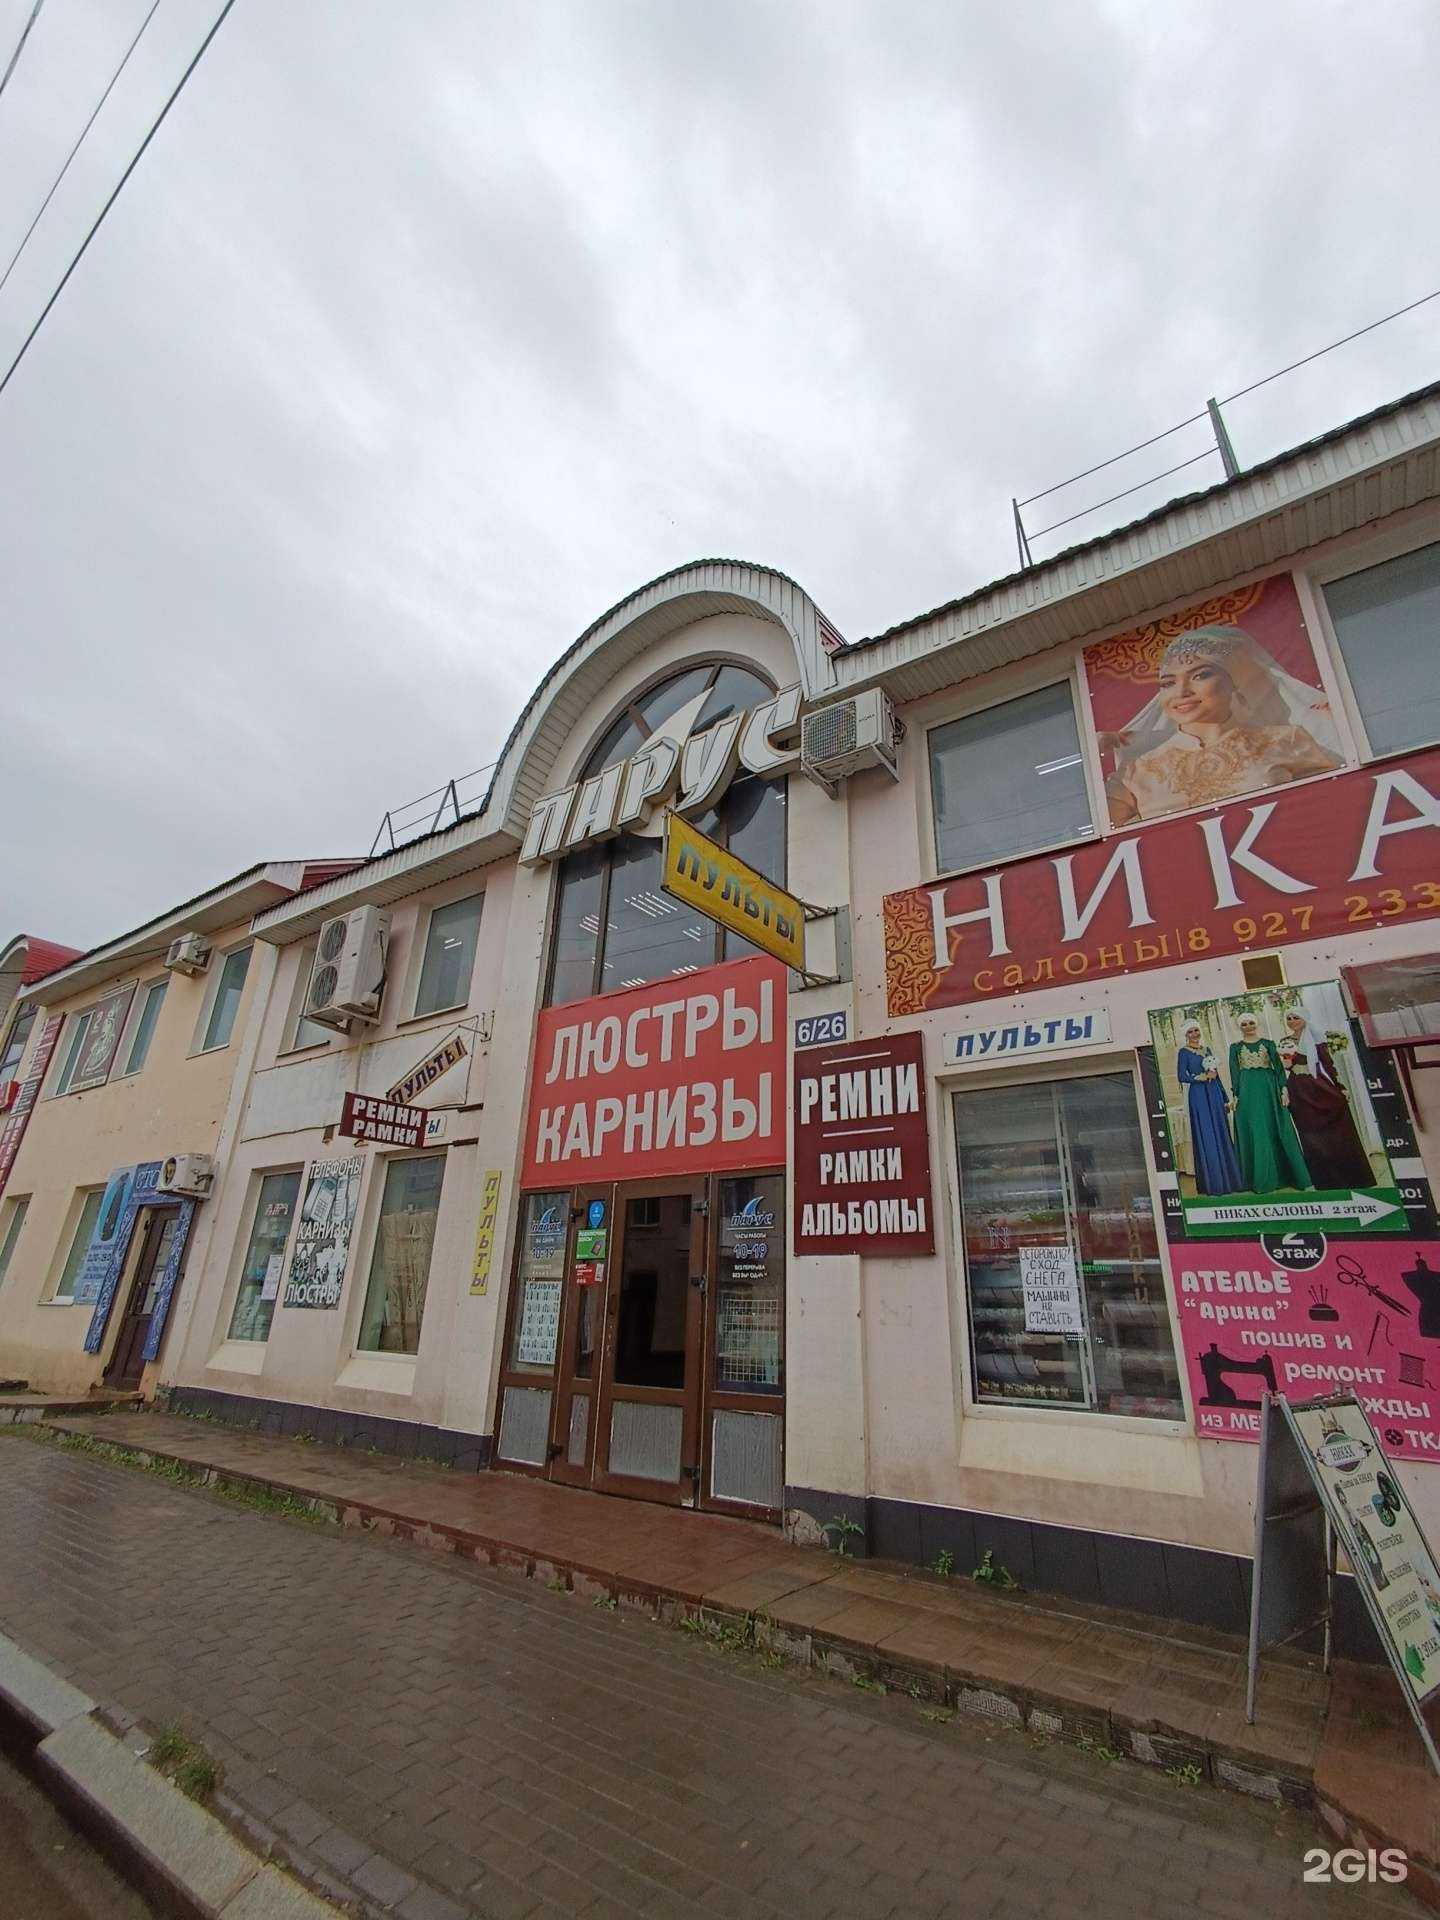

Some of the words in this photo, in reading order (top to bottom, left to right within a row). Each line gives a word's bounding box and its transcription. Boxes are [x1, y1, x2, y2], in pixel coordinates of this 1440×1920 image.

[519, 683, 803, 866] ПАРУС
[927, 769, 1440, 969] НИКА
[677, 842, 795, 943] ПУЛЬТЫ
[973, 935, 1170, 992] салоны
[1187, 927, 1211, 951] 8
[1233, 906, 1314, 942] 927
[545, 980, 773, 1084] ЛЮСТРЫ
[798, 1016, 844, 1043] 6/26
[956, 1016, 1093, 1057] ПУЛЬТЫ
[391, 1040, 462, 1103] ПУЛЬТЫ
[800, 1063, 919, 1124] РЕМНИ
[352, 1098, 423, 1128] РЕМНИ
[536, 1072, 772, 1163] КАРНИЗЫ
[352, 1119, 418, 1145] РАМКИ
[310, 1156, 364, 1179] ТЕЛЕФОНЫ
[820, 1147, 902, 1185] РАМКИ
[801, 1198, 926, 1236] АЛЬБОМЫ
[1214, 1208, 1259, 1220] НИКАХ
[1263, 1205, 1323, 1218] САЛОНЫ
[1332, 1206, 1341, 1215] 2
[1342, 1204, 1378, 1215] этаж
[297, 1220, 352, 1240] КАРНИЗЫ
[471, 1177, 498, 1287] ПУЛЬТЫ
[1272, 1247, 1320, 1260] этаж
[1026, 1271, 1065, 1286] СНЕГА
[1181, 1271, 1292, 1294] АТЕЛЬЕ
[285, 1283, 341, 1305] ЛЮСТРЫ
[1241, 1330, 1326, 1349] пошив
[1335, 1334, 1353, 1350] и
[1284, 1361, 1386, 1385] ремонт
[1230, 1413, 1262, 1431] МЕ
[1405, 1429, 1440, 1450] ТК
